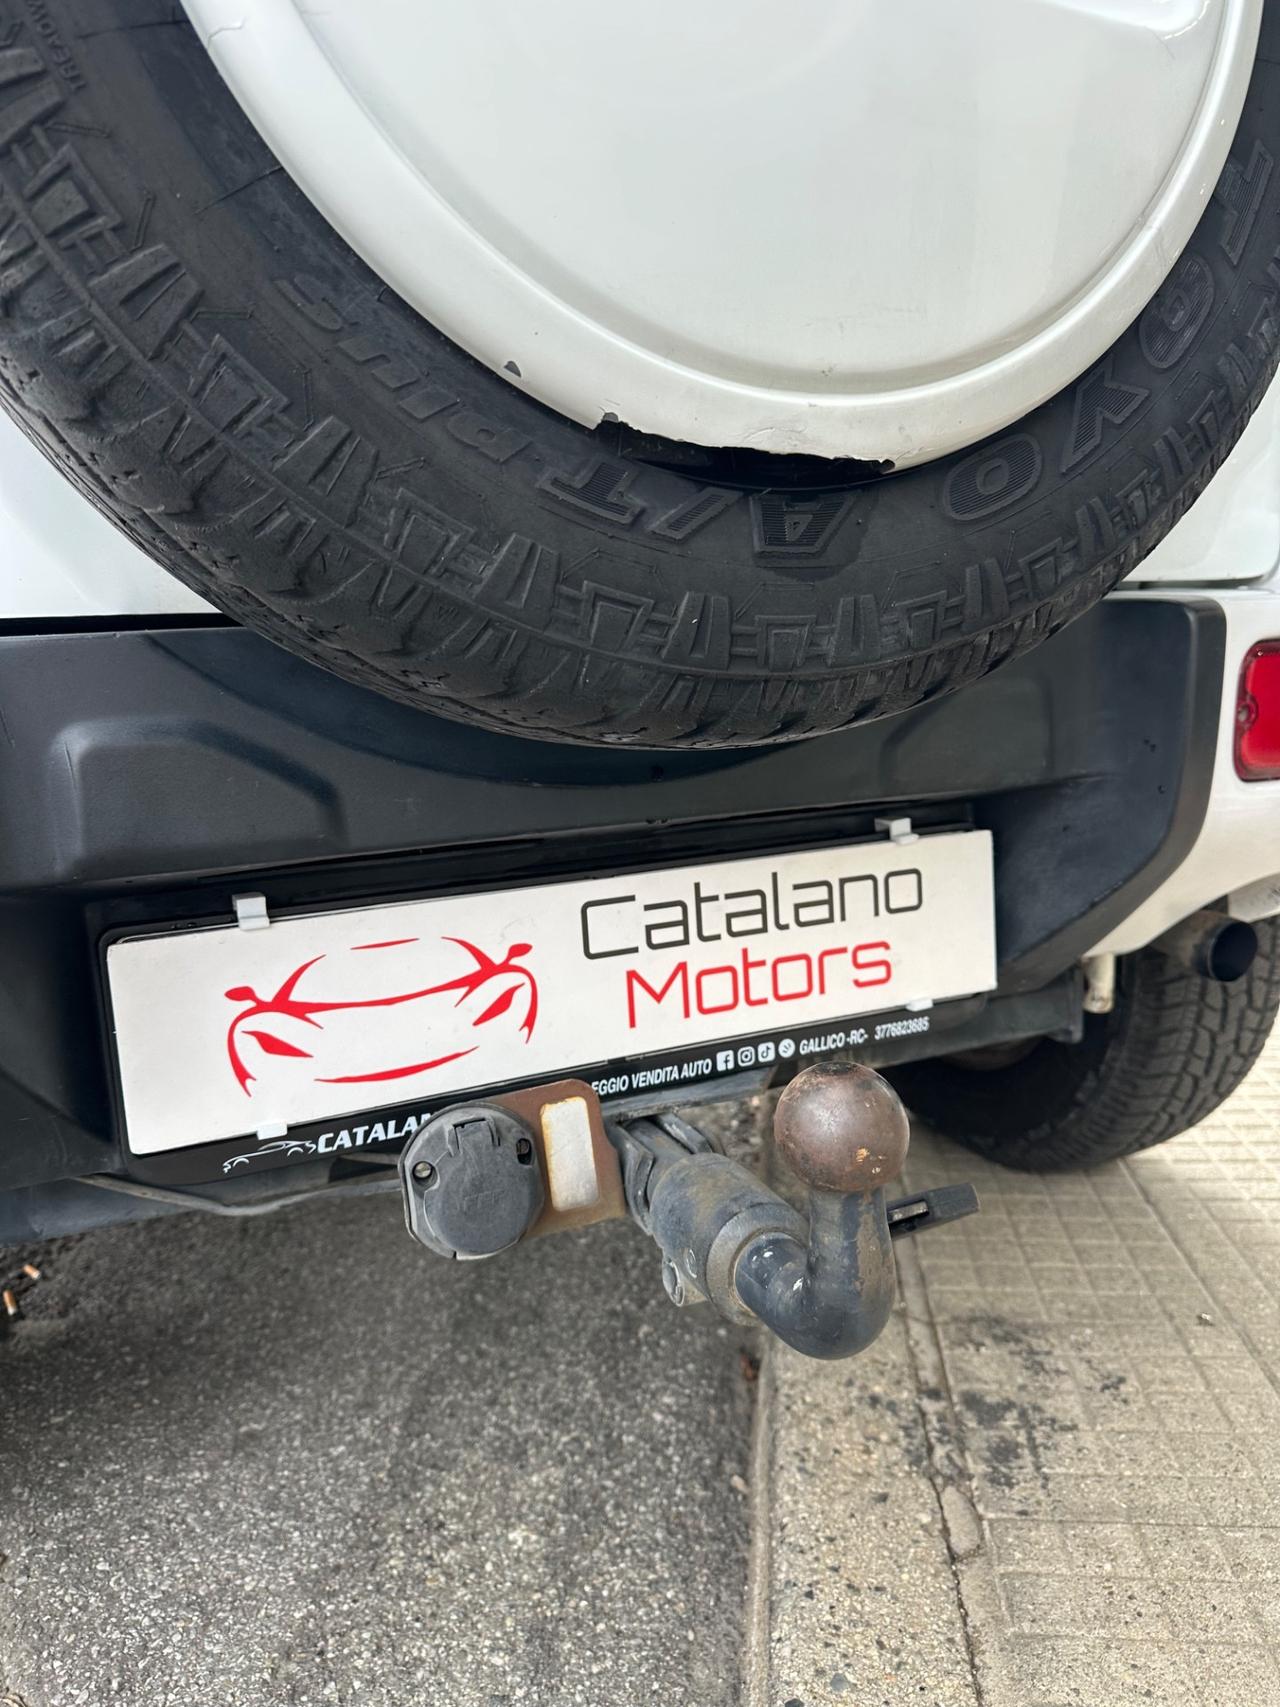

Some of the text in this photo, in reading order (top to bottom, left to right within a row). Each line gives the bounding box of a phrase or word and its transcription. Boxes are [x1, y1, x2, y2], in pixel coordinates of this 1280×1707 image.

[943, 138, 1273, 521] TOYO
[580, 867, 923, 960] Catalano
[625, 940, 893, 1029] Motors
[630, 1064, 682, 1089] VENDITA
[680, 1058, 713, 1079] AUTO
[799, 1031, 846, 1056] GALLICO
